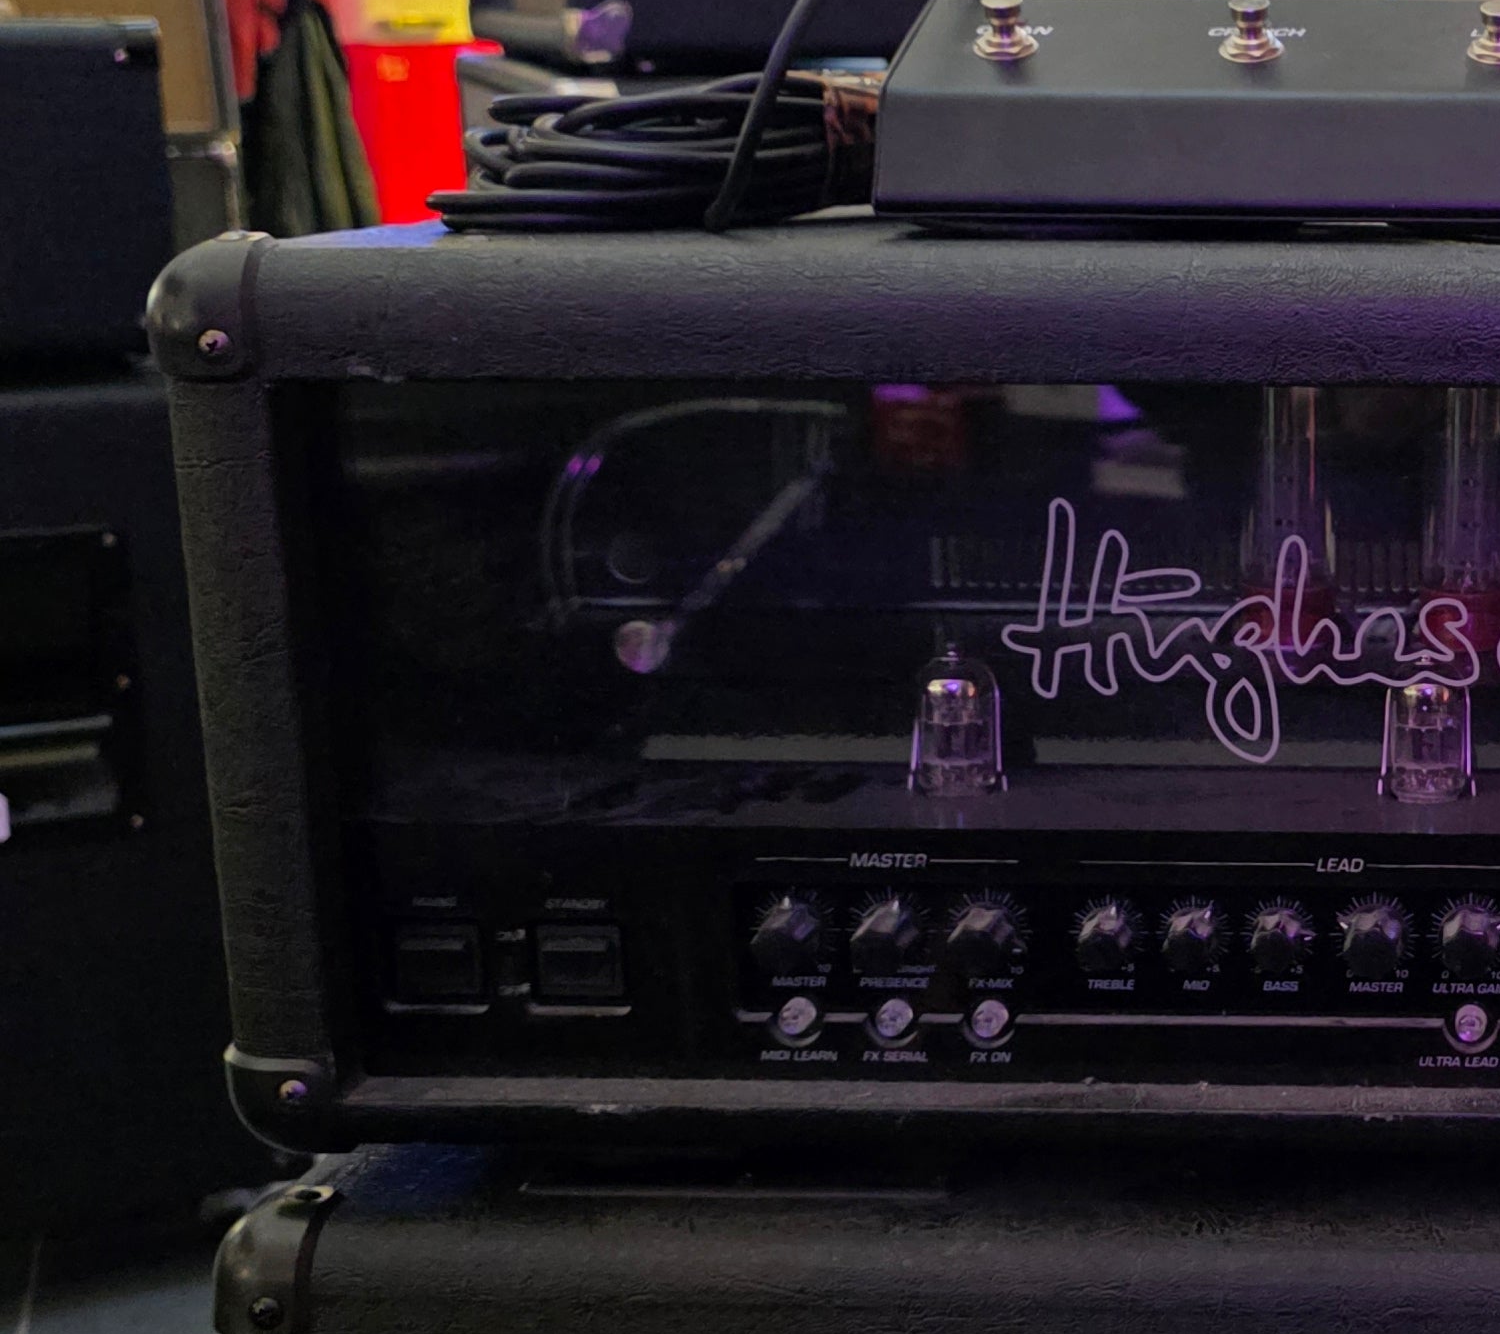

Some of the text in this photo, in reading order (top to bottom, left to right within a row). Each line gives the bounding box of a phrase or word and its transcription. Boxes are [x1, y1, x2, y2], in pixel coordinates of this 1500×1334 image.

[1001, 497, 1482, 763] Hughes
[849, 853, 928, 868] MASTER
[1316, 857, 1364, 873] LEAD
[771, 975, 827, 988] MASTER
[859, 976, 930, 989] PRESENCE
[1087, 979, 1136, 991] TREBLE
[1182, 979, 1211, 991] MID
[1262, 980, 1300, 992] BASS
[1348, 981, 1404, 993] MASTER
[1432, 983, 1475, 994] ULTRA
[792, 1050, 839, 1063] LEARN
[862, 1050, 929, 1063] FX SERIAL
[969, 1051, 1012, 1063] FX ON
[1418, 1056, 1463, 1067] ULTRA
[1463, 1056, 1499, 1068] LEAD
